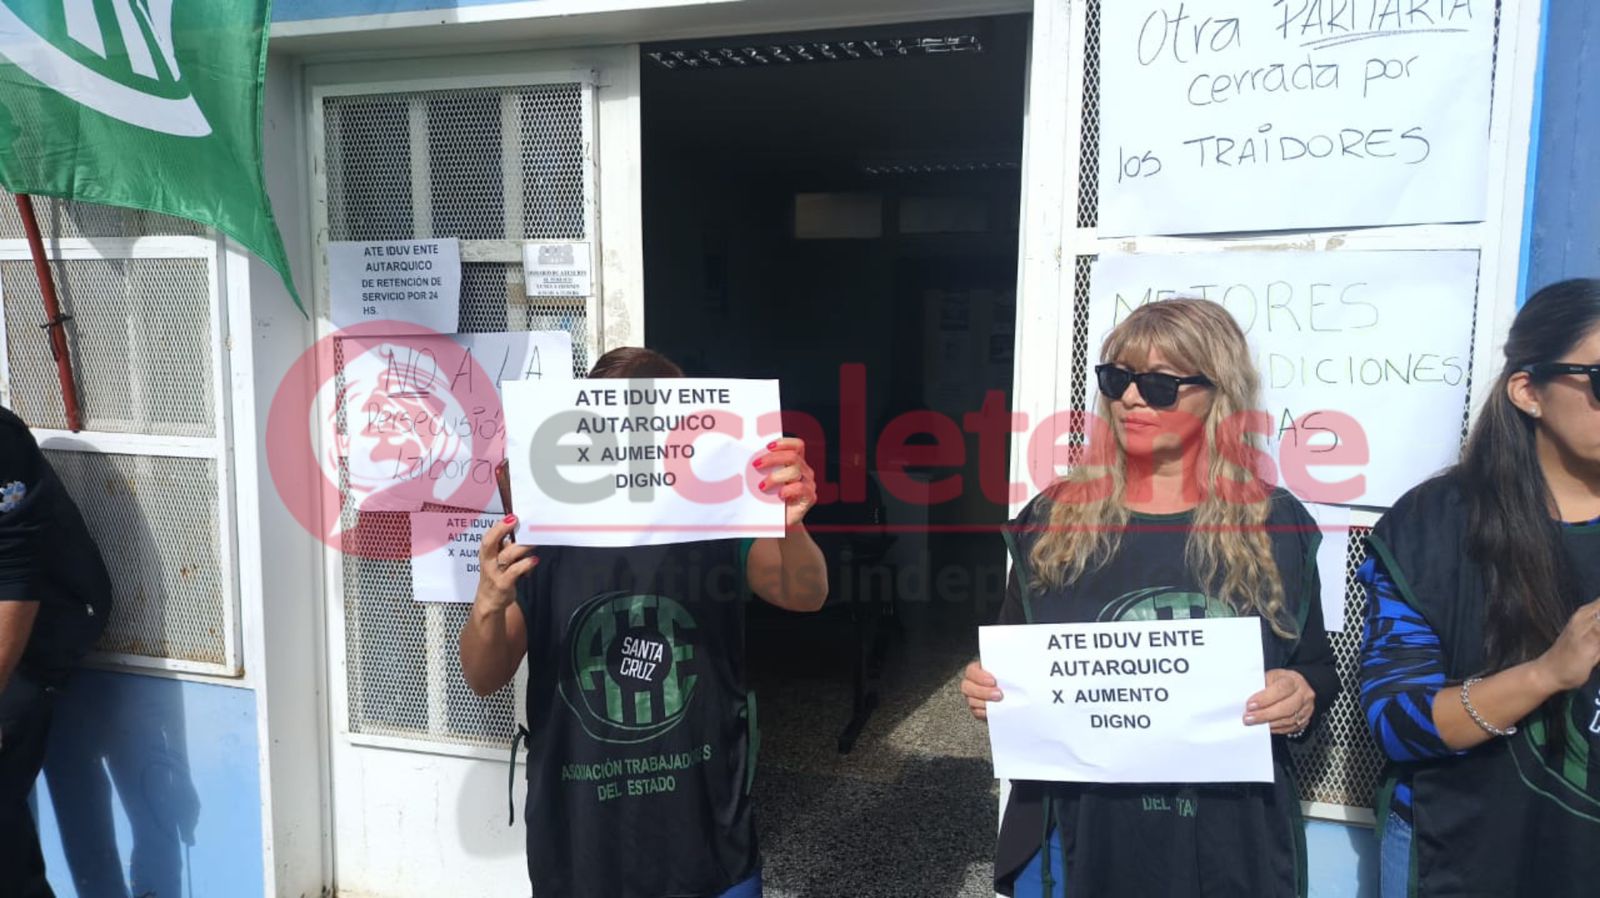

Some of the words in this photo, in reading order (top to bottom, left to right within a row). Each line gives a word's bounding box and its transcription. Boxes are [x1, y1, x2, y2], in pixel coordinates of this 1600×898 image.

[1138, 3, 1241, 66] Otra
[1187, 54, 1339, 106] cerrada
[1363, 55, 1421, 98] por
[1117, 146, 1162, 183] los
[364, 246, 384, 257] ATE
[386, 245, 410, 256] IDUV
[413, 244, 439, 255] ENTE
[365, 260, 433, 272] AUTARQUICO
[362, 279, 375, 288] DE
[431, 276, 442, 287] DE
[362, 291, 406, 302] SERVICIO
[407, 291, 427, 301] POR
[429, 291, 439, 301] 24
[1113, 280, 1379, 333] MORES
[385, 346, 438, 390] NO
[450, 346, 473, 393] A
[1258, 352, 1464, 390] DICIONES
[575, 389, 618, 407] ATE
[624, 388, 673, 405] IDUV
[679, 388, 731, 404] ENTE
[576, 414, 717, 435] AUTARQUICO
[577, 447, 590, 463] X
[601, 444, 695, 462] AUMENTO
[616, 472, 677, 489] DIGNO
[447, 518, 468, 528] ATE
[470, 519, 494, 529] IDUV
[621, 636, 664, 663] SANTA
[1047, 634, 1086, 650] ATE
[1093, 632, 1142, 649] IDUV
[1149, 630, 1205, 647] ENTE
[619, 657, 657, 682] CRUZ
[1049, 658, 1190, 678] AUTARQUICO
[1052, 689, 1065, 704] X
[1074, 687, 1169, 704] AUMENTO
[1090, 714, 1151, 730] DIGNO
[624, 743, 712, 775] TRABAJADS
[597, 782, 622, 802] DEL
[627, 775, 676, 796] ESTADO
[1141, 796, 1171, 812] DEL
